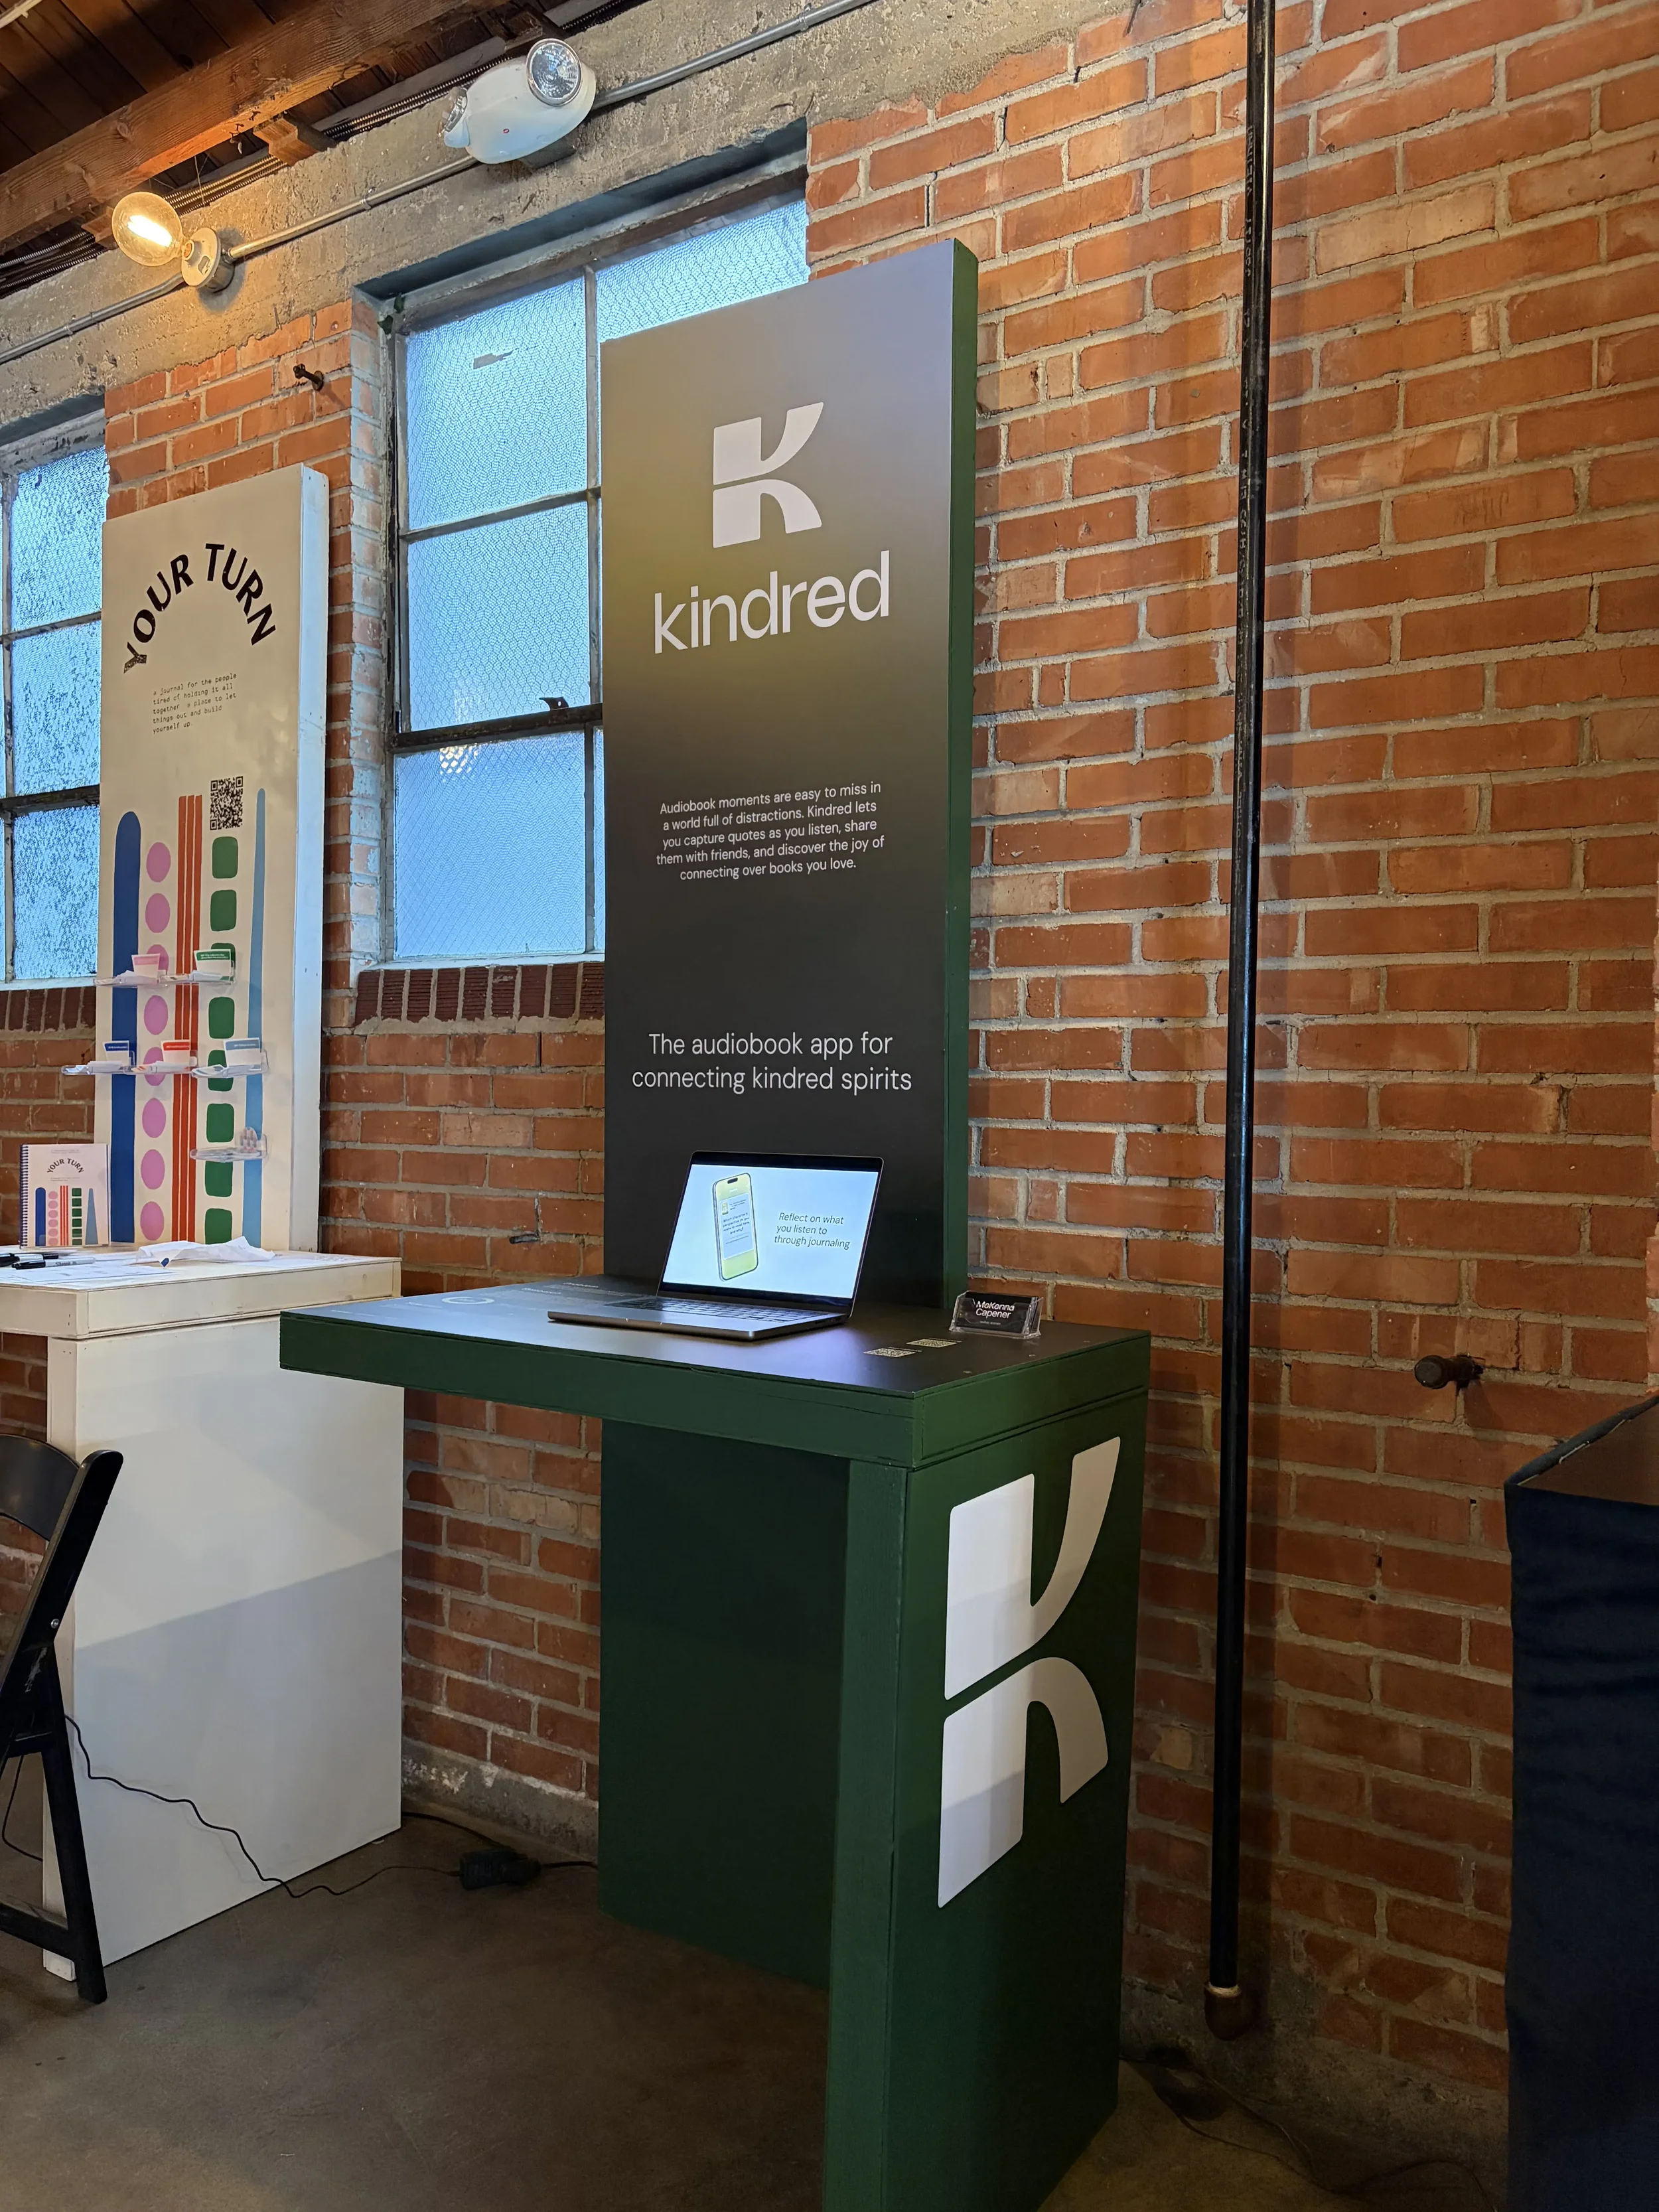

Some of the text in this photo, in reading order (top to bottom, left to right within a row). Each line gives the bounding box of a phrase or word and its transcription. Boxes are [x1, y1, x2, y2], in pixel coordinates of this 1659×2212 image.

[123, 543, 276, 674] YOUR TURN
[654, 550, 889, 654] kindred
[160, 684, 183, 696] journal
[215, 673, 237, 683] people
[184, 689, 208, 698] holding
[194, 699, 211, 707] place
[153, 722, 180, 734] yourself
[660, 781, 881, 814] Audiobook moments are easy to miss in
[663, 801, 877, 831] a world full of distractions. Kindred lets
[663, 819, 877, 850] you capture quotes as you listen, share
[656, 835, 885, 865] them with friends, and discover the joy of
[680, 857, 856, 880] connecting over books you love.
[649, 1031, 893, 1060] The audiobook app for
[632, 1066, 912, 1096] connecting kindred spirits
[47, 1158, 84, 1173] YOUR TURN
[779, 1213, 808, 1222] Reflect
[823, 1215, 844, 1224] what
[794, 1224, 816, 1234] listen
[774, 1235, 850, 1250] through journaling
[975, 1308, 1011, 1319] Capener
